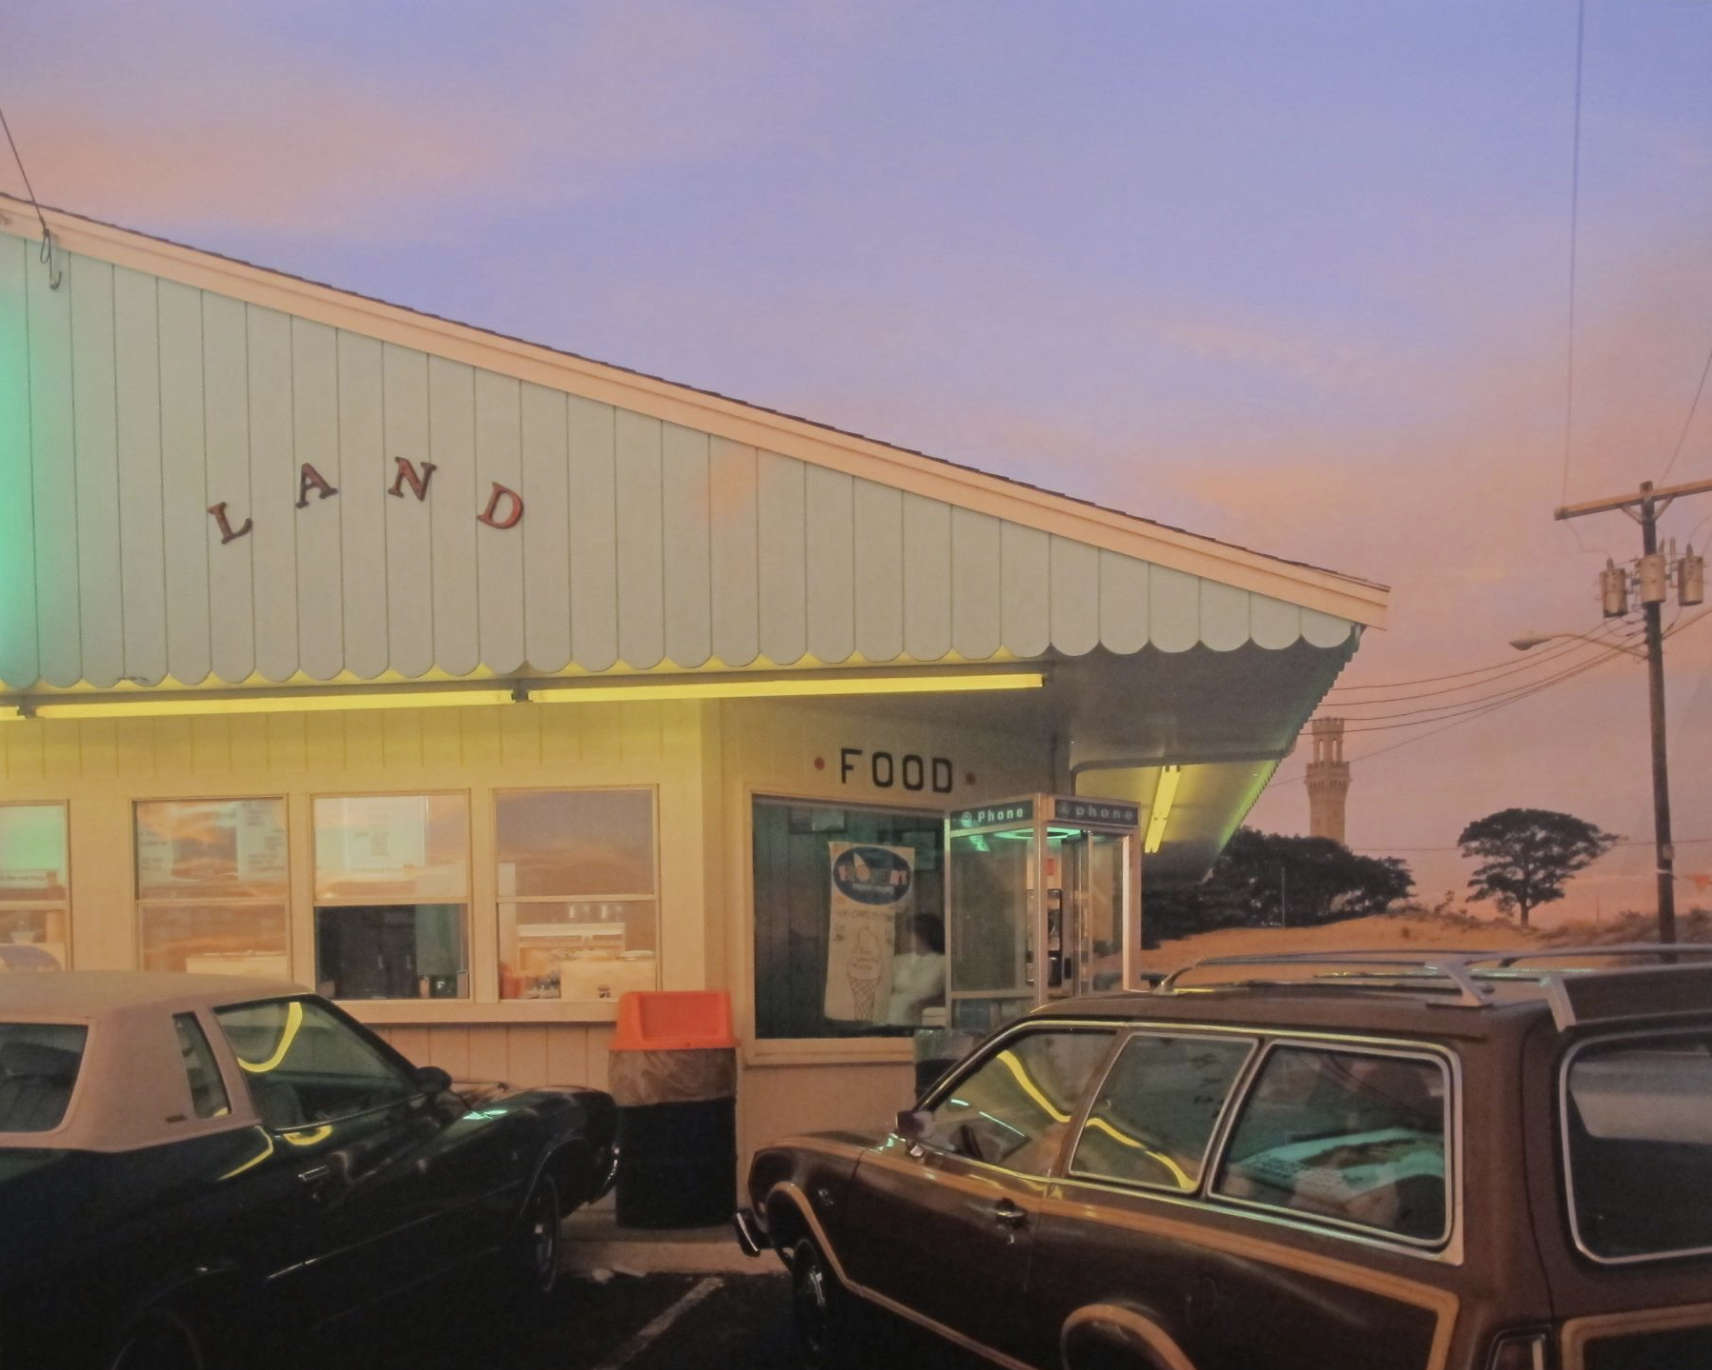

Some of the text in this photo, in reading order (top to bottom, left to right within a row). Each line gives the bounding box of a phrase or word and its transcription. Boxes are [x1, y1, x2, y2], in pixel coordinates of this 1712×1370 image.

[207, 457, 525, 544] LAND
[841, 748, 953, 793] FOOD
[977, 806, 1024, 823] Phone
